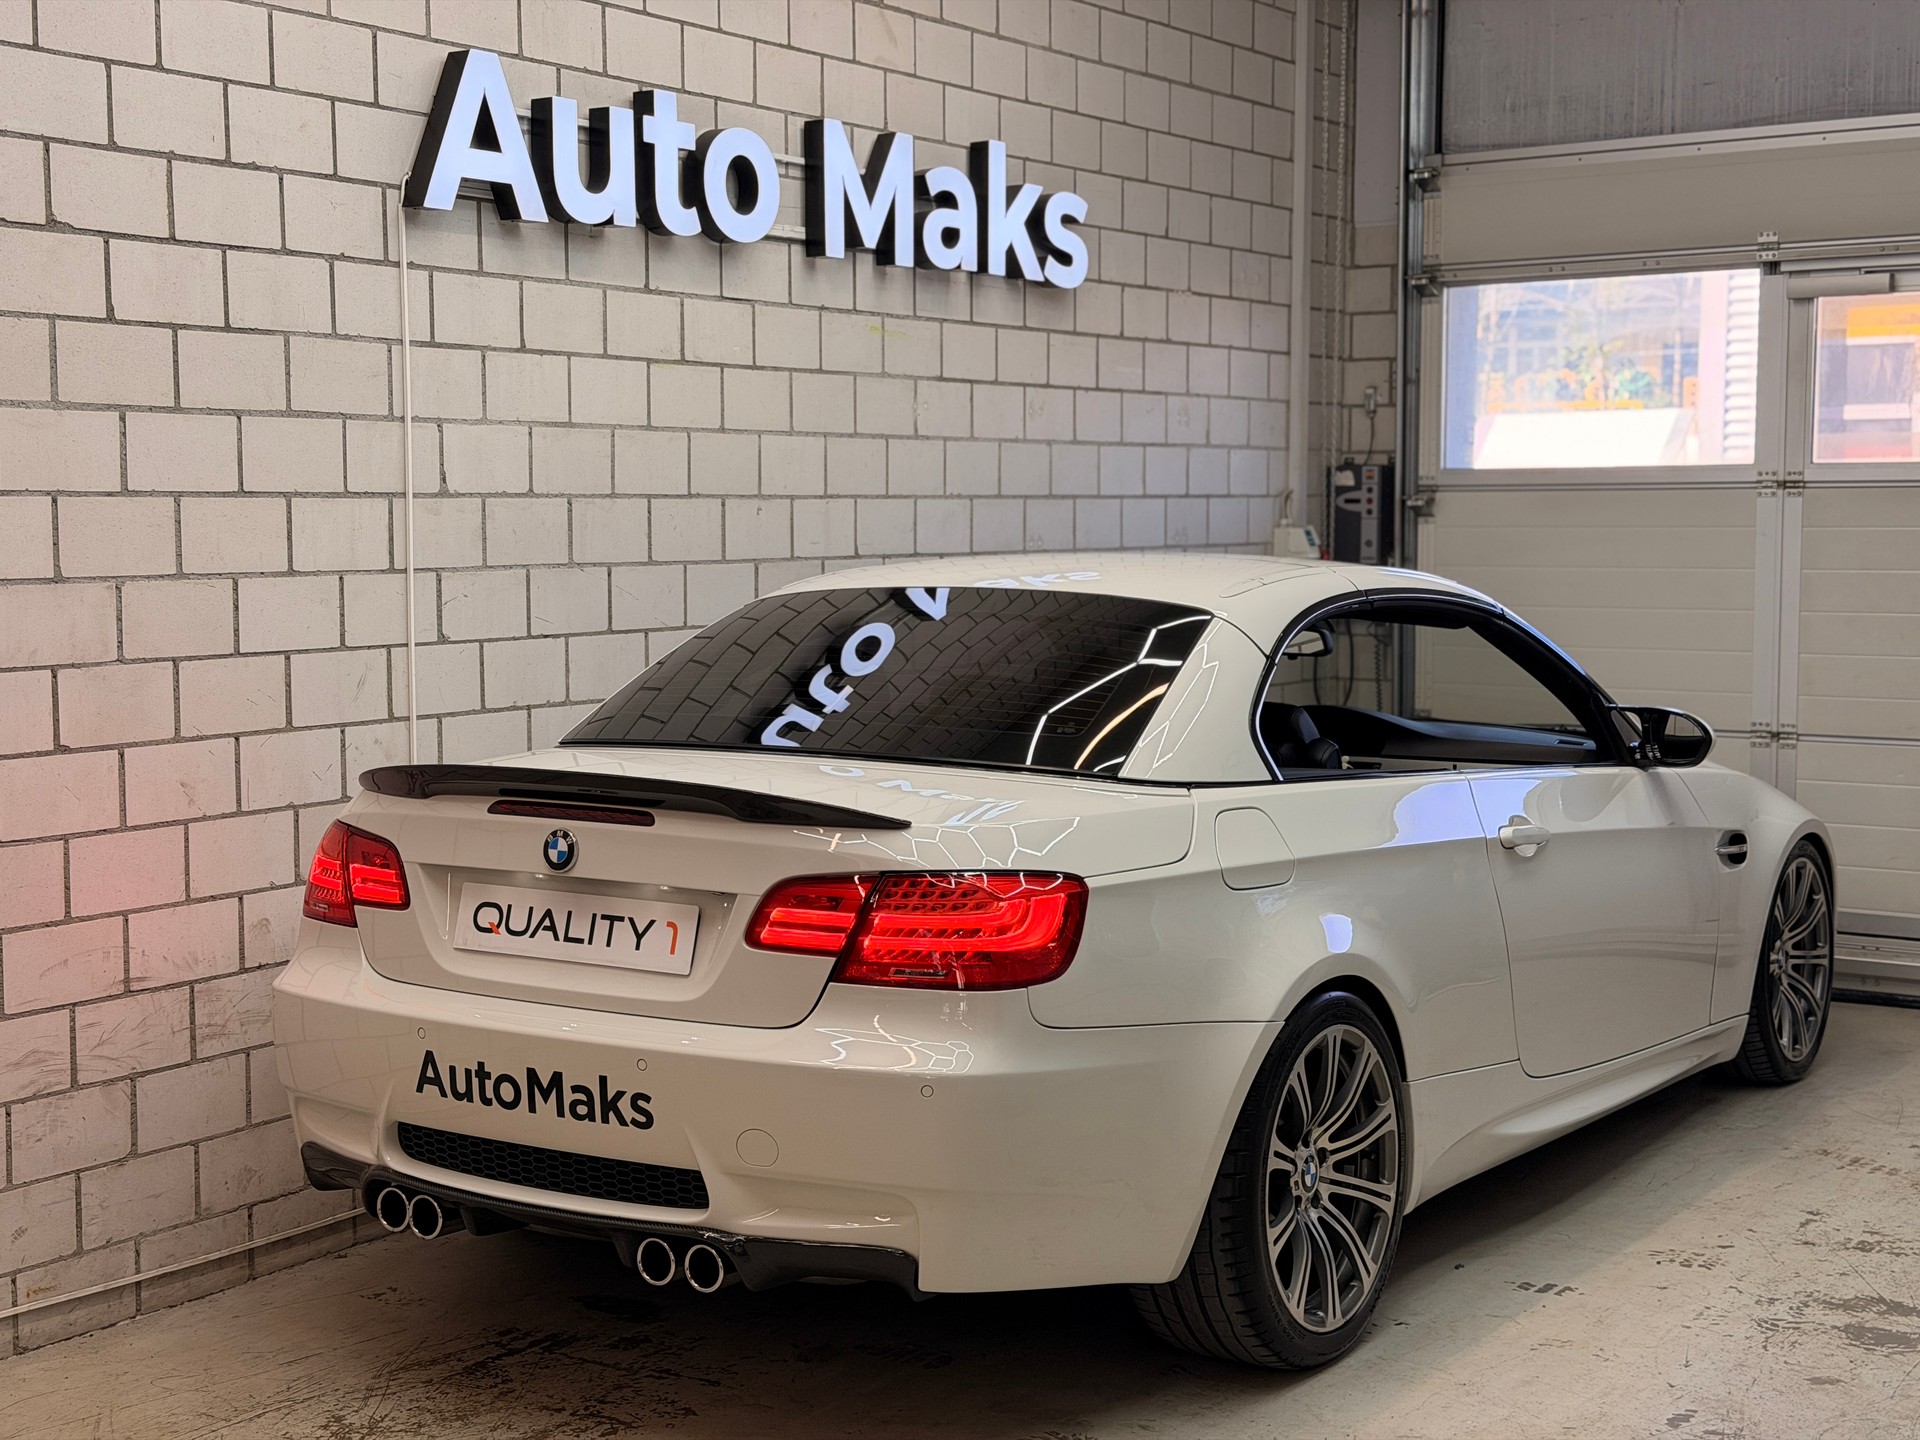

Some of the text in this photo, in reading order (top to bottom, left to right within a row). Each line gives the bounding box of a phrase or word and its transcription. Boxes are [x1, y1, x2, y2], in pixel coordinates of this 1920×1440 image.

[422, 48, 1089, 289] Auto Maks
[547, 830, 573, 845] BMW
[473, 901, 679, 956] QUALITY 1
[415, 1049, 655, 1130] AutoMaks
